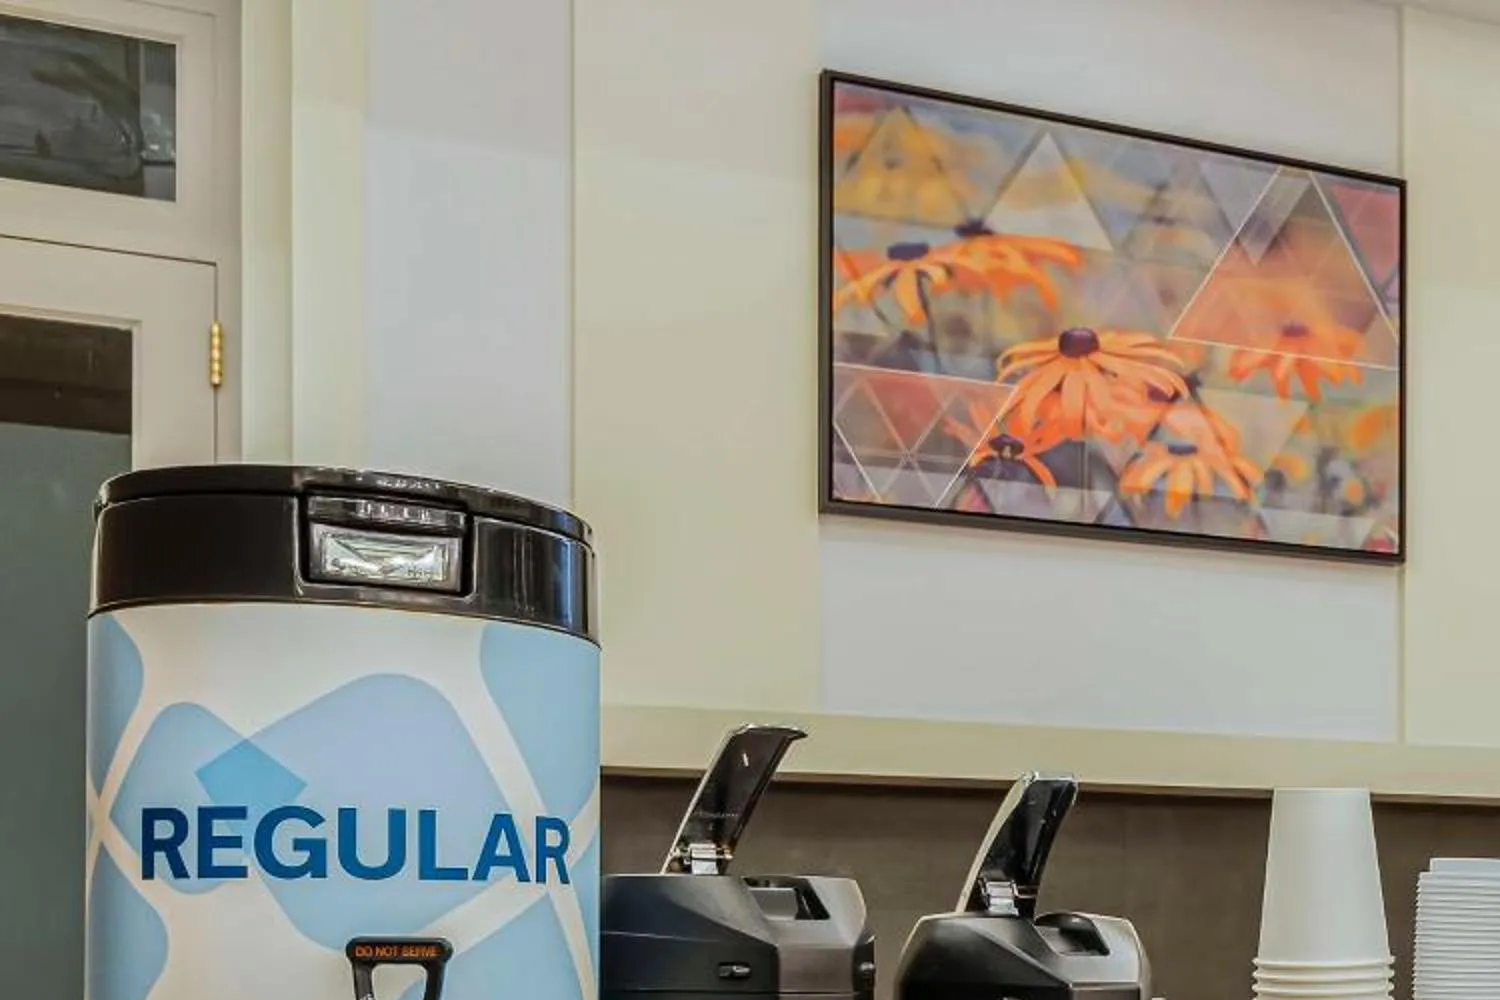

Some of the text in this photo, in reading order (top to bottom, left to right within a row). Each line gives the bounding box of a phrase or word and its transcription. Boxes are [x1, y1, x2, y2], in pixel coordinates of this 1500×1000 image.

[140, 805, 572, 885] REGULAR
[355, 944, 373, 957] DO
[375, 944, 398, 957] NOT
